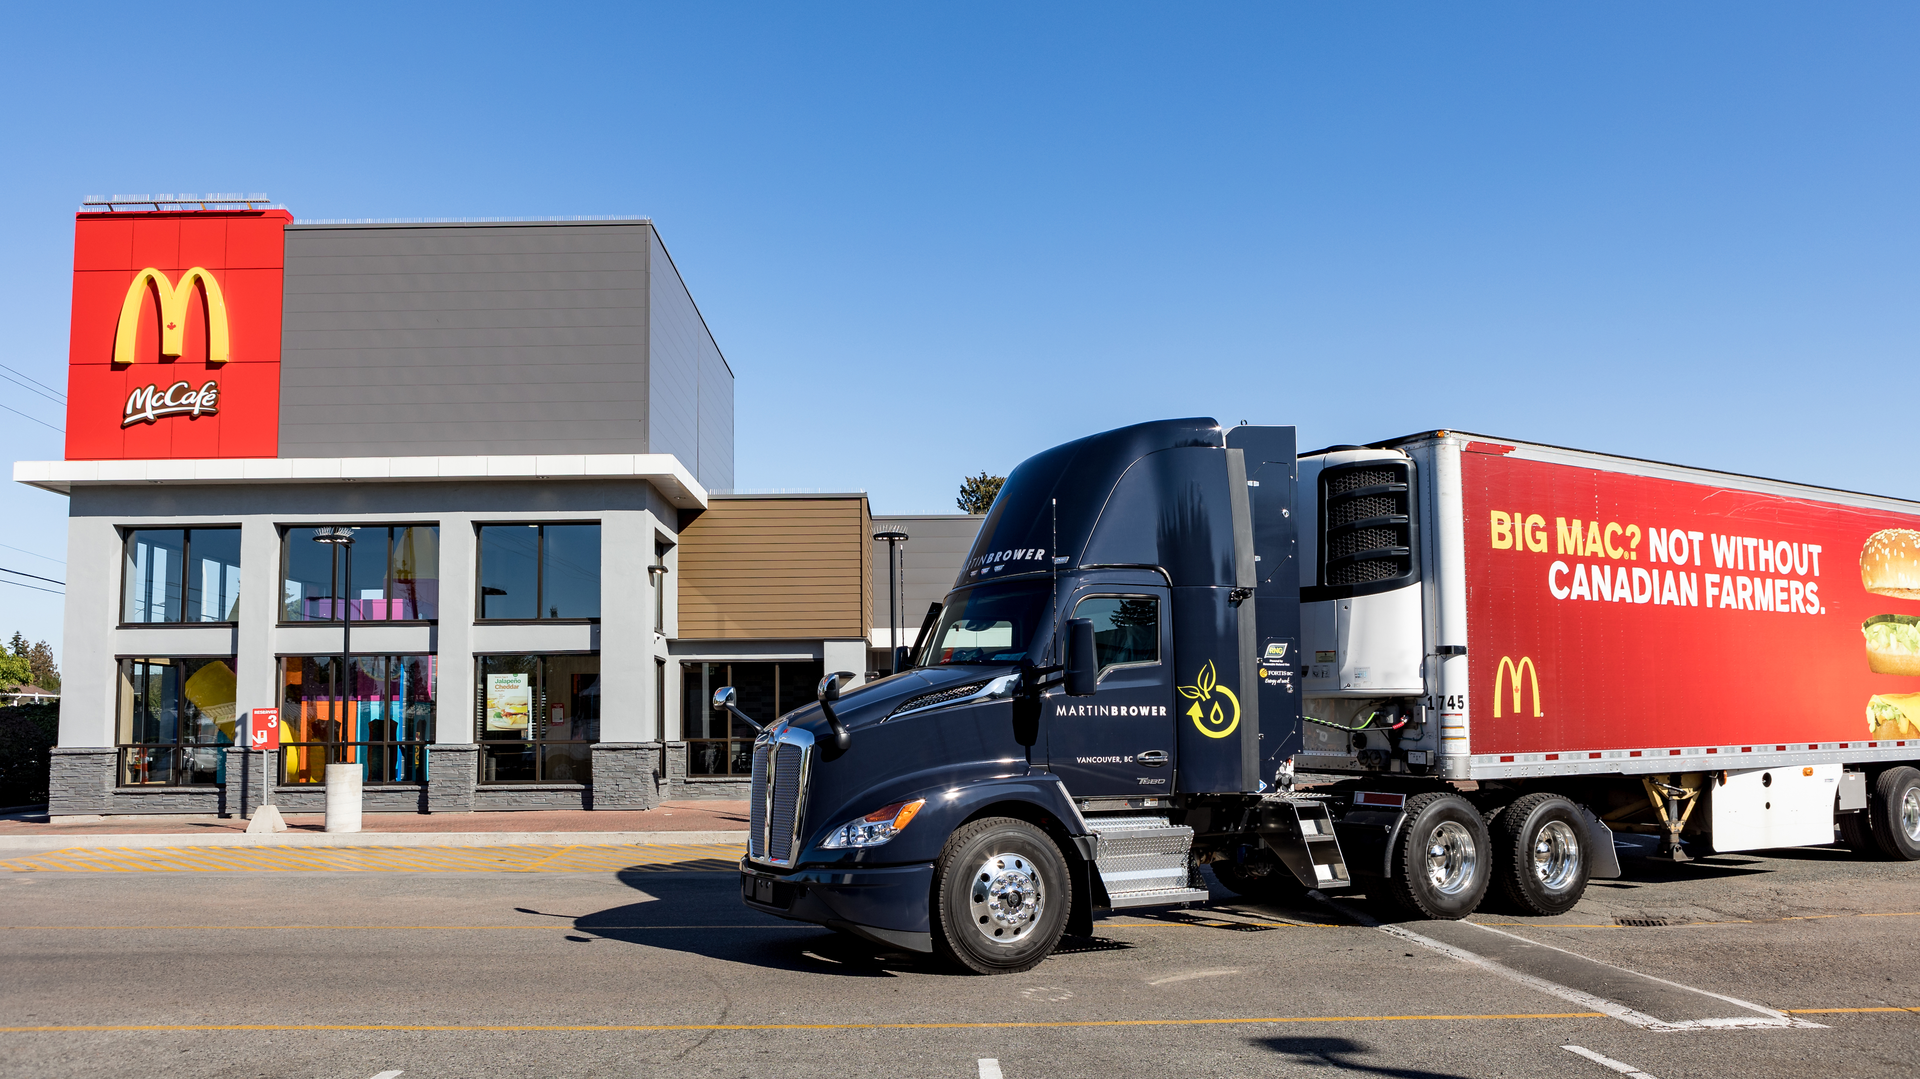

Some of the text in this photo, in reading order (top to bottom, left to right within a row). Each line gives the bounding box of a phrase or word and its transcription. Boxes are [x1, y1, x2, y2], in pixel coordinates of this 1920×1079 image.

[124, 381, 218, 421] McCafé
[1490, 510, 1548, 553] BIG
[1649, 527, 1704, 566] NOT
[1710, 533, 1822, 577] WITHOUT
[1548, 560, 1826, 615] CANADIAN FARMERS.
[494, 677, 521, 685] Jalapeño
[1056, 705, 1167, 717] MARTINBROWER
[267, 715, 278, 728] 3
[1076, 755, 1133, 764] VANCOUVER, BC
